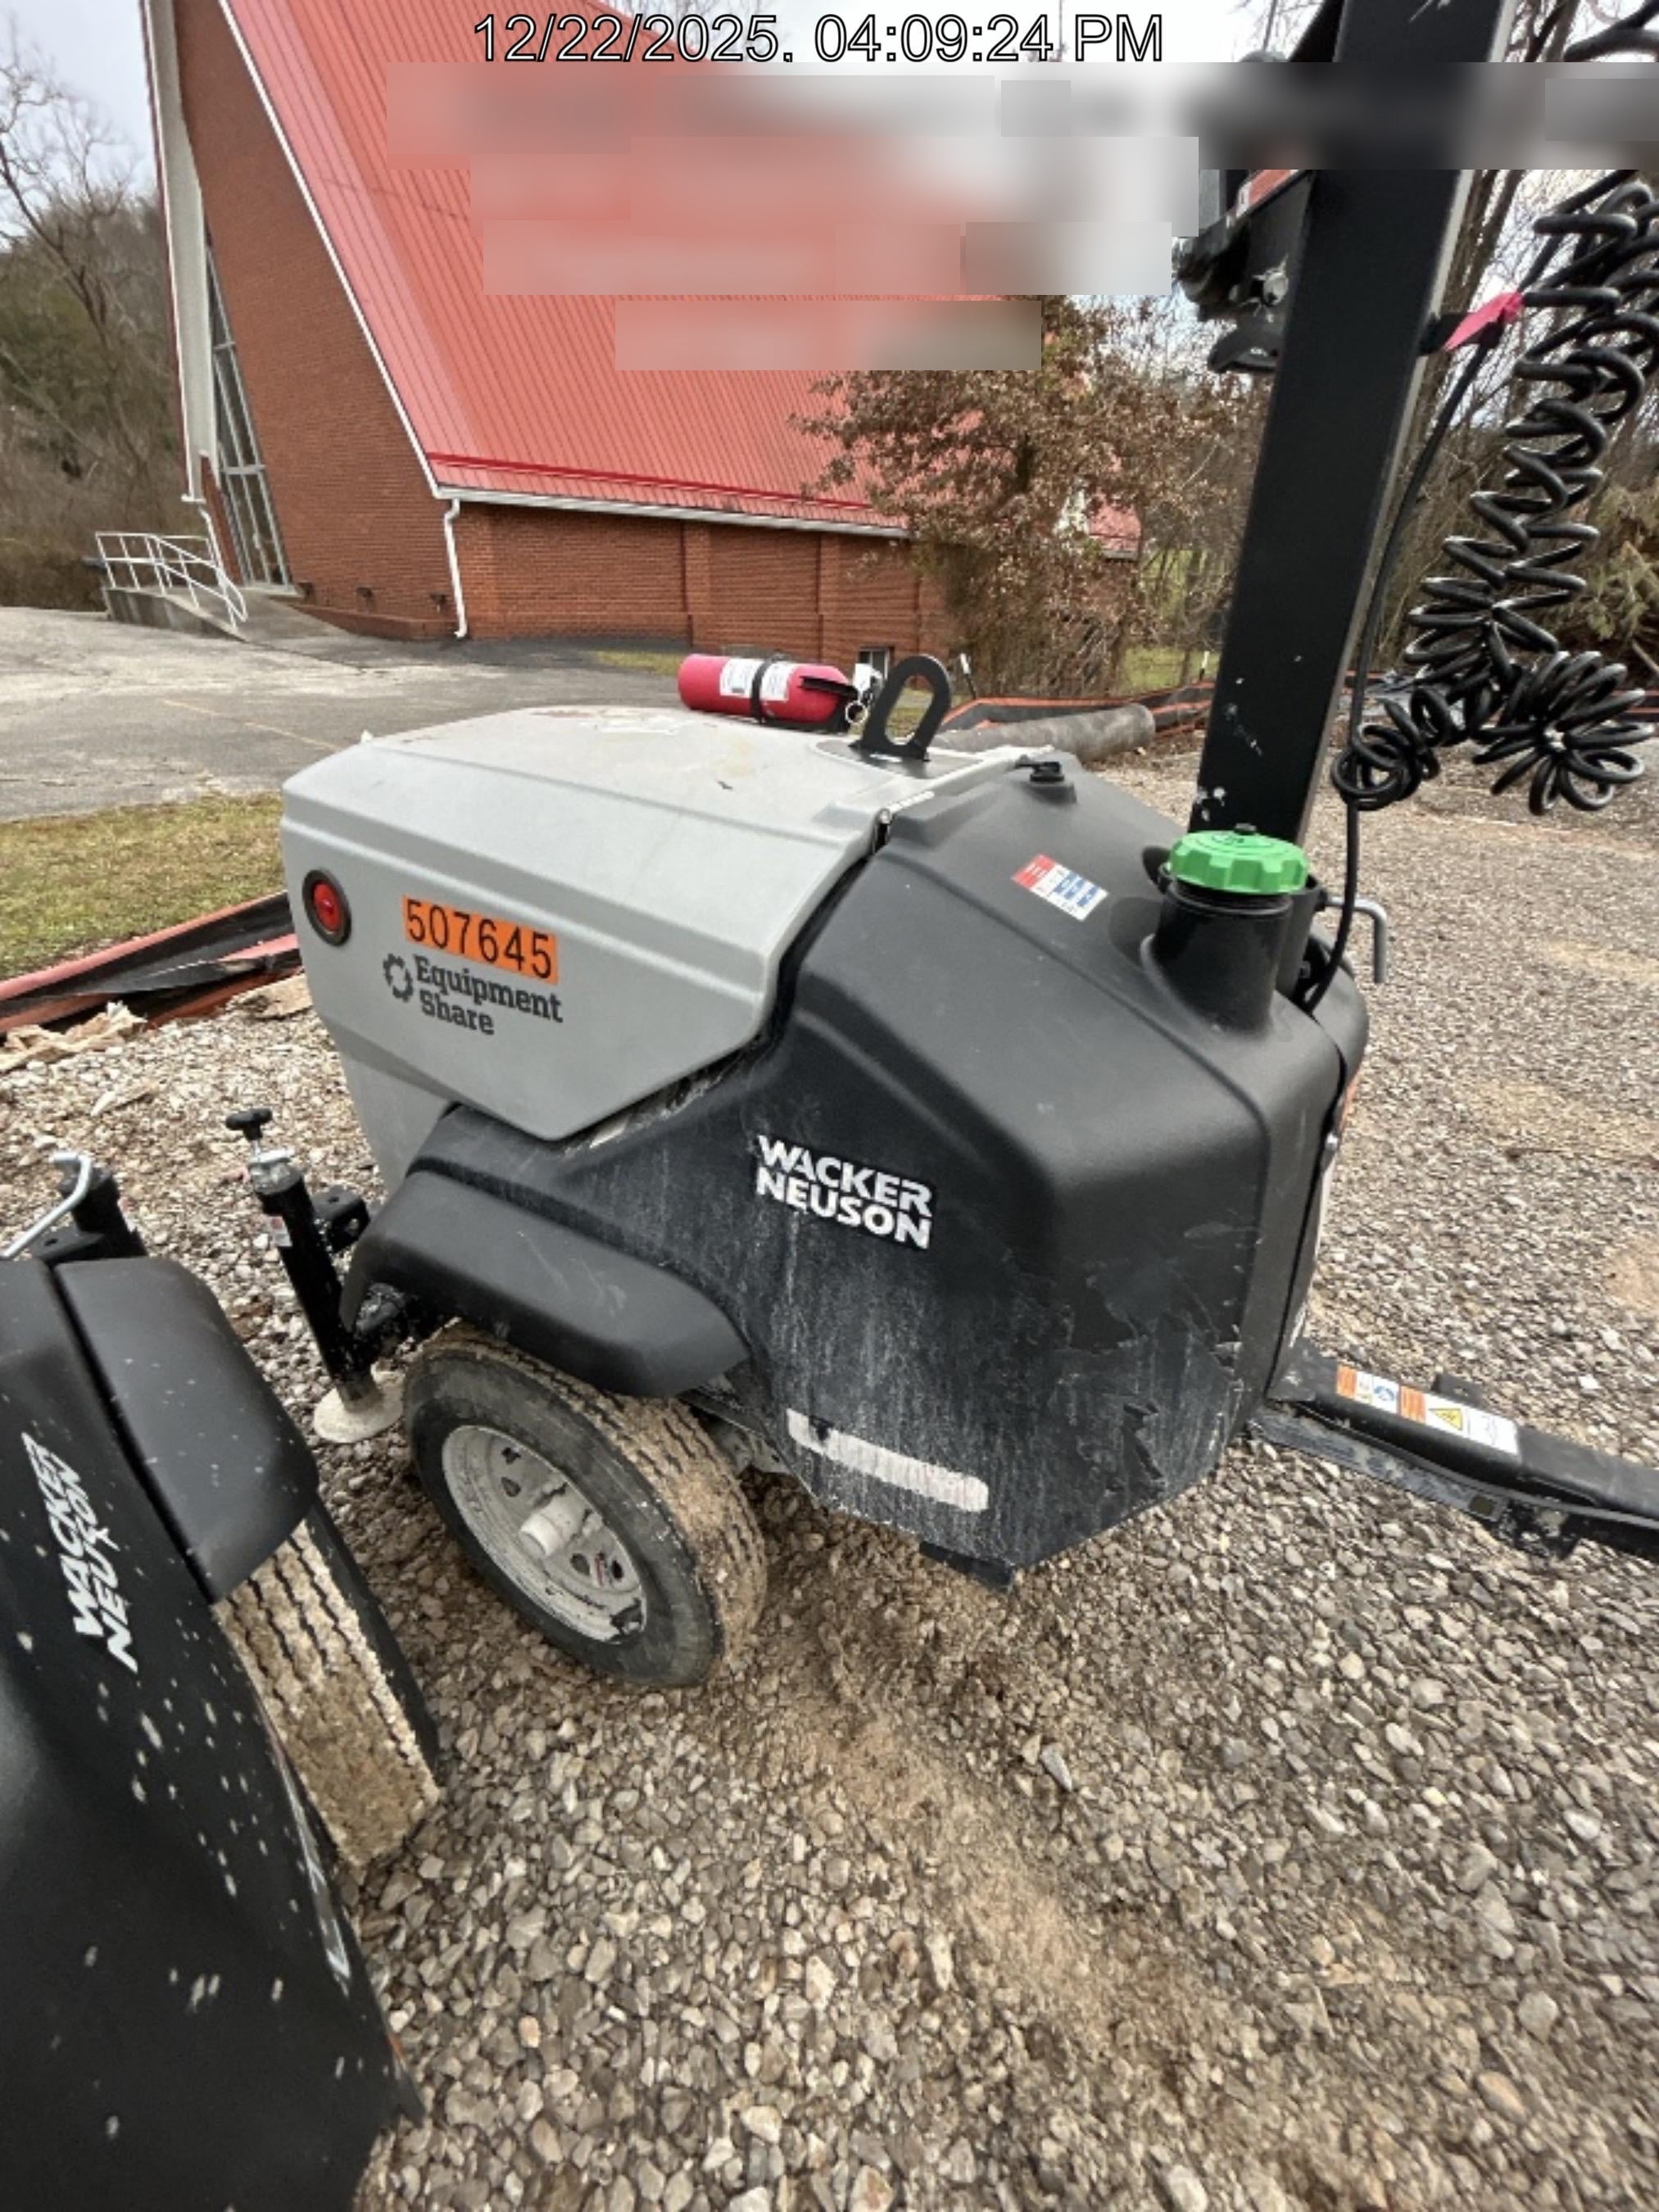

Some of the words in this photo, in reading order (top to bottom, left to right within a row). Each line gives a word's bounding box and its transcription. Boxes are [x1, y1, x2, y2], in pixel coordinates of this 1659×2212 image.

[406, 899, 551, 978] 507645
[413, 954, 563, 1022] Equipment
[419, 990, 495, 1035] Share
[755, 1166, 932, 1249] NEUSON
[758, 1134, 932, 1217] WACKER
[21, 1432, 105, 1637] WACKER
[37, 1444, 138, 1674] NEUSON
